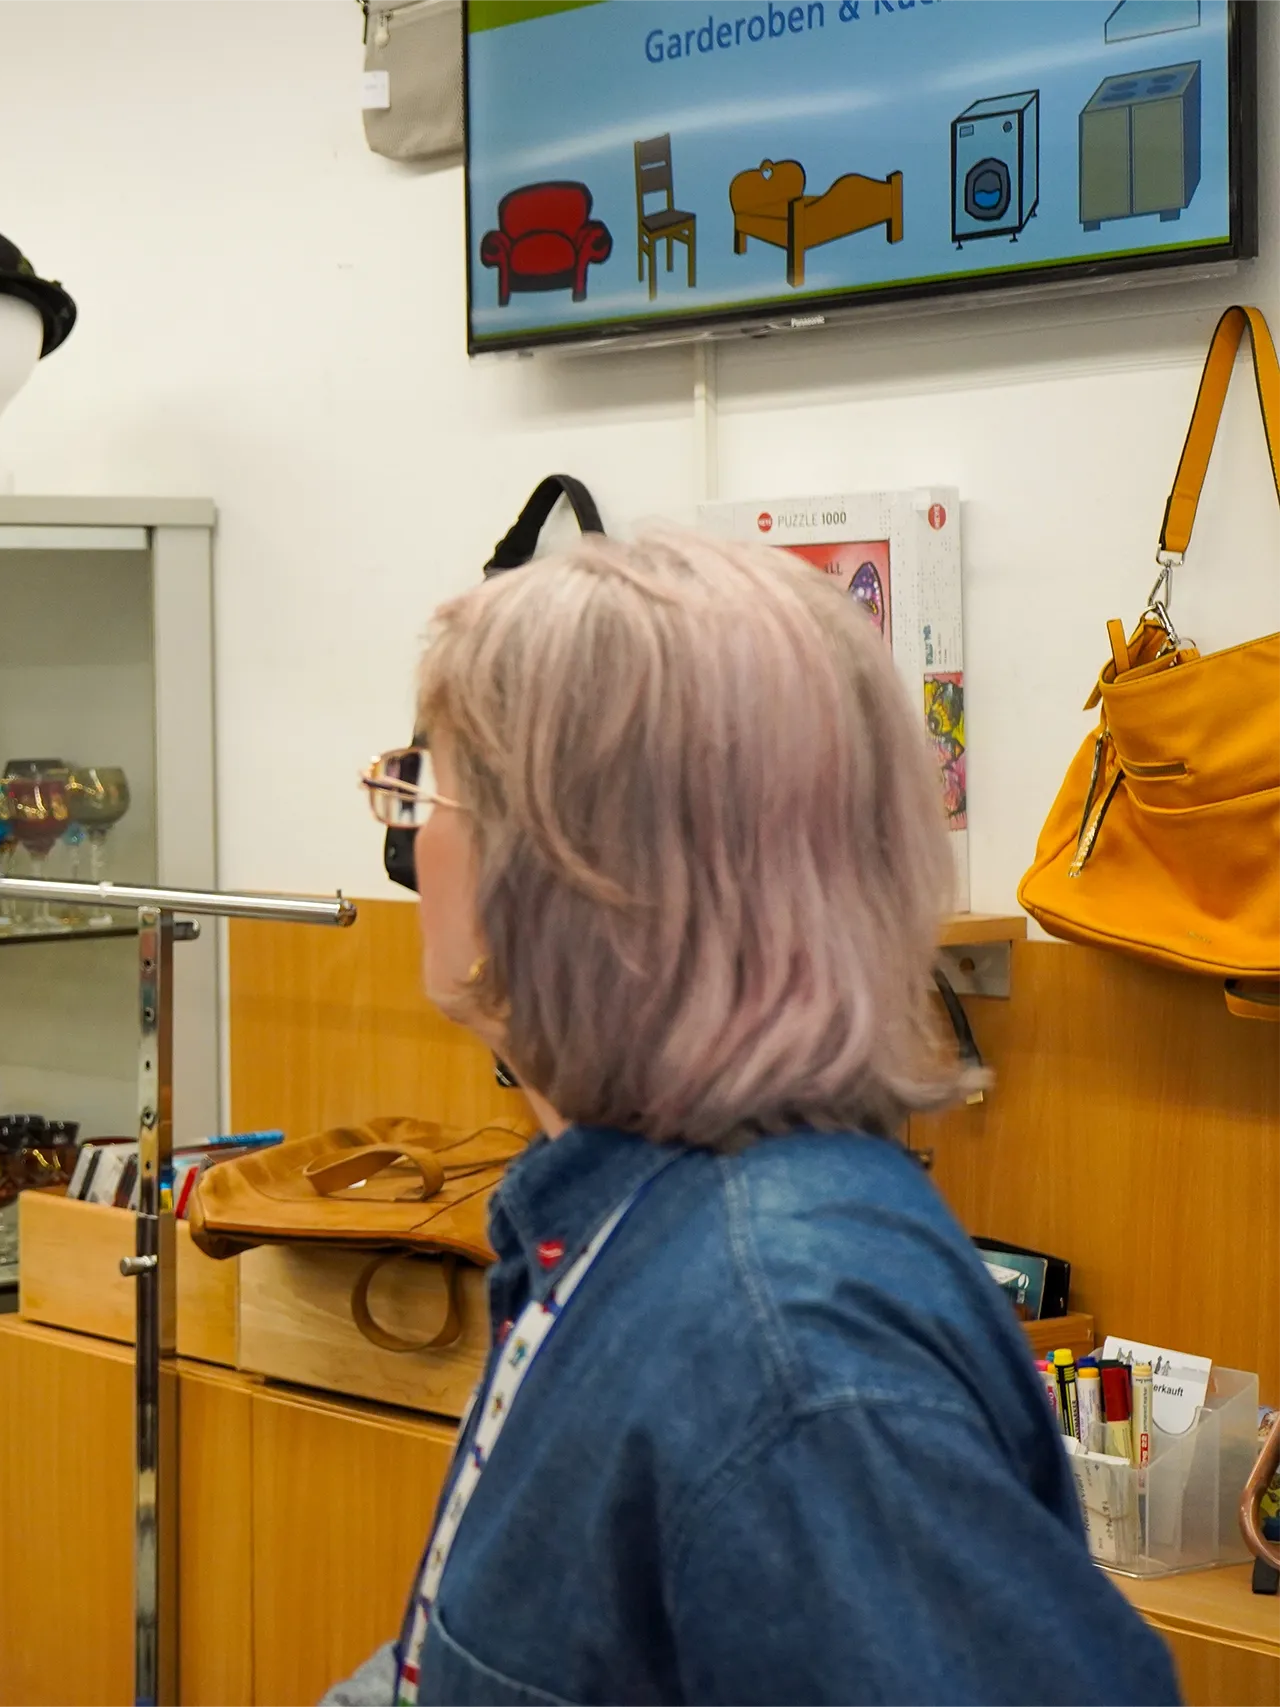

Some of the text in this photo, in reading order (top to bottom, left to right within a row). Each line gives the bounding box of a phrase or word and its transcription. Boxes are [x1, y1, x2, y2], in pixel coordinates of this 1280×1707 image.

[645, 2, 825, 63] Garderoben
[778, 512, 847, 528] PUZZLE 1000
[1153, 1384, 1185, 1398] erkauft
